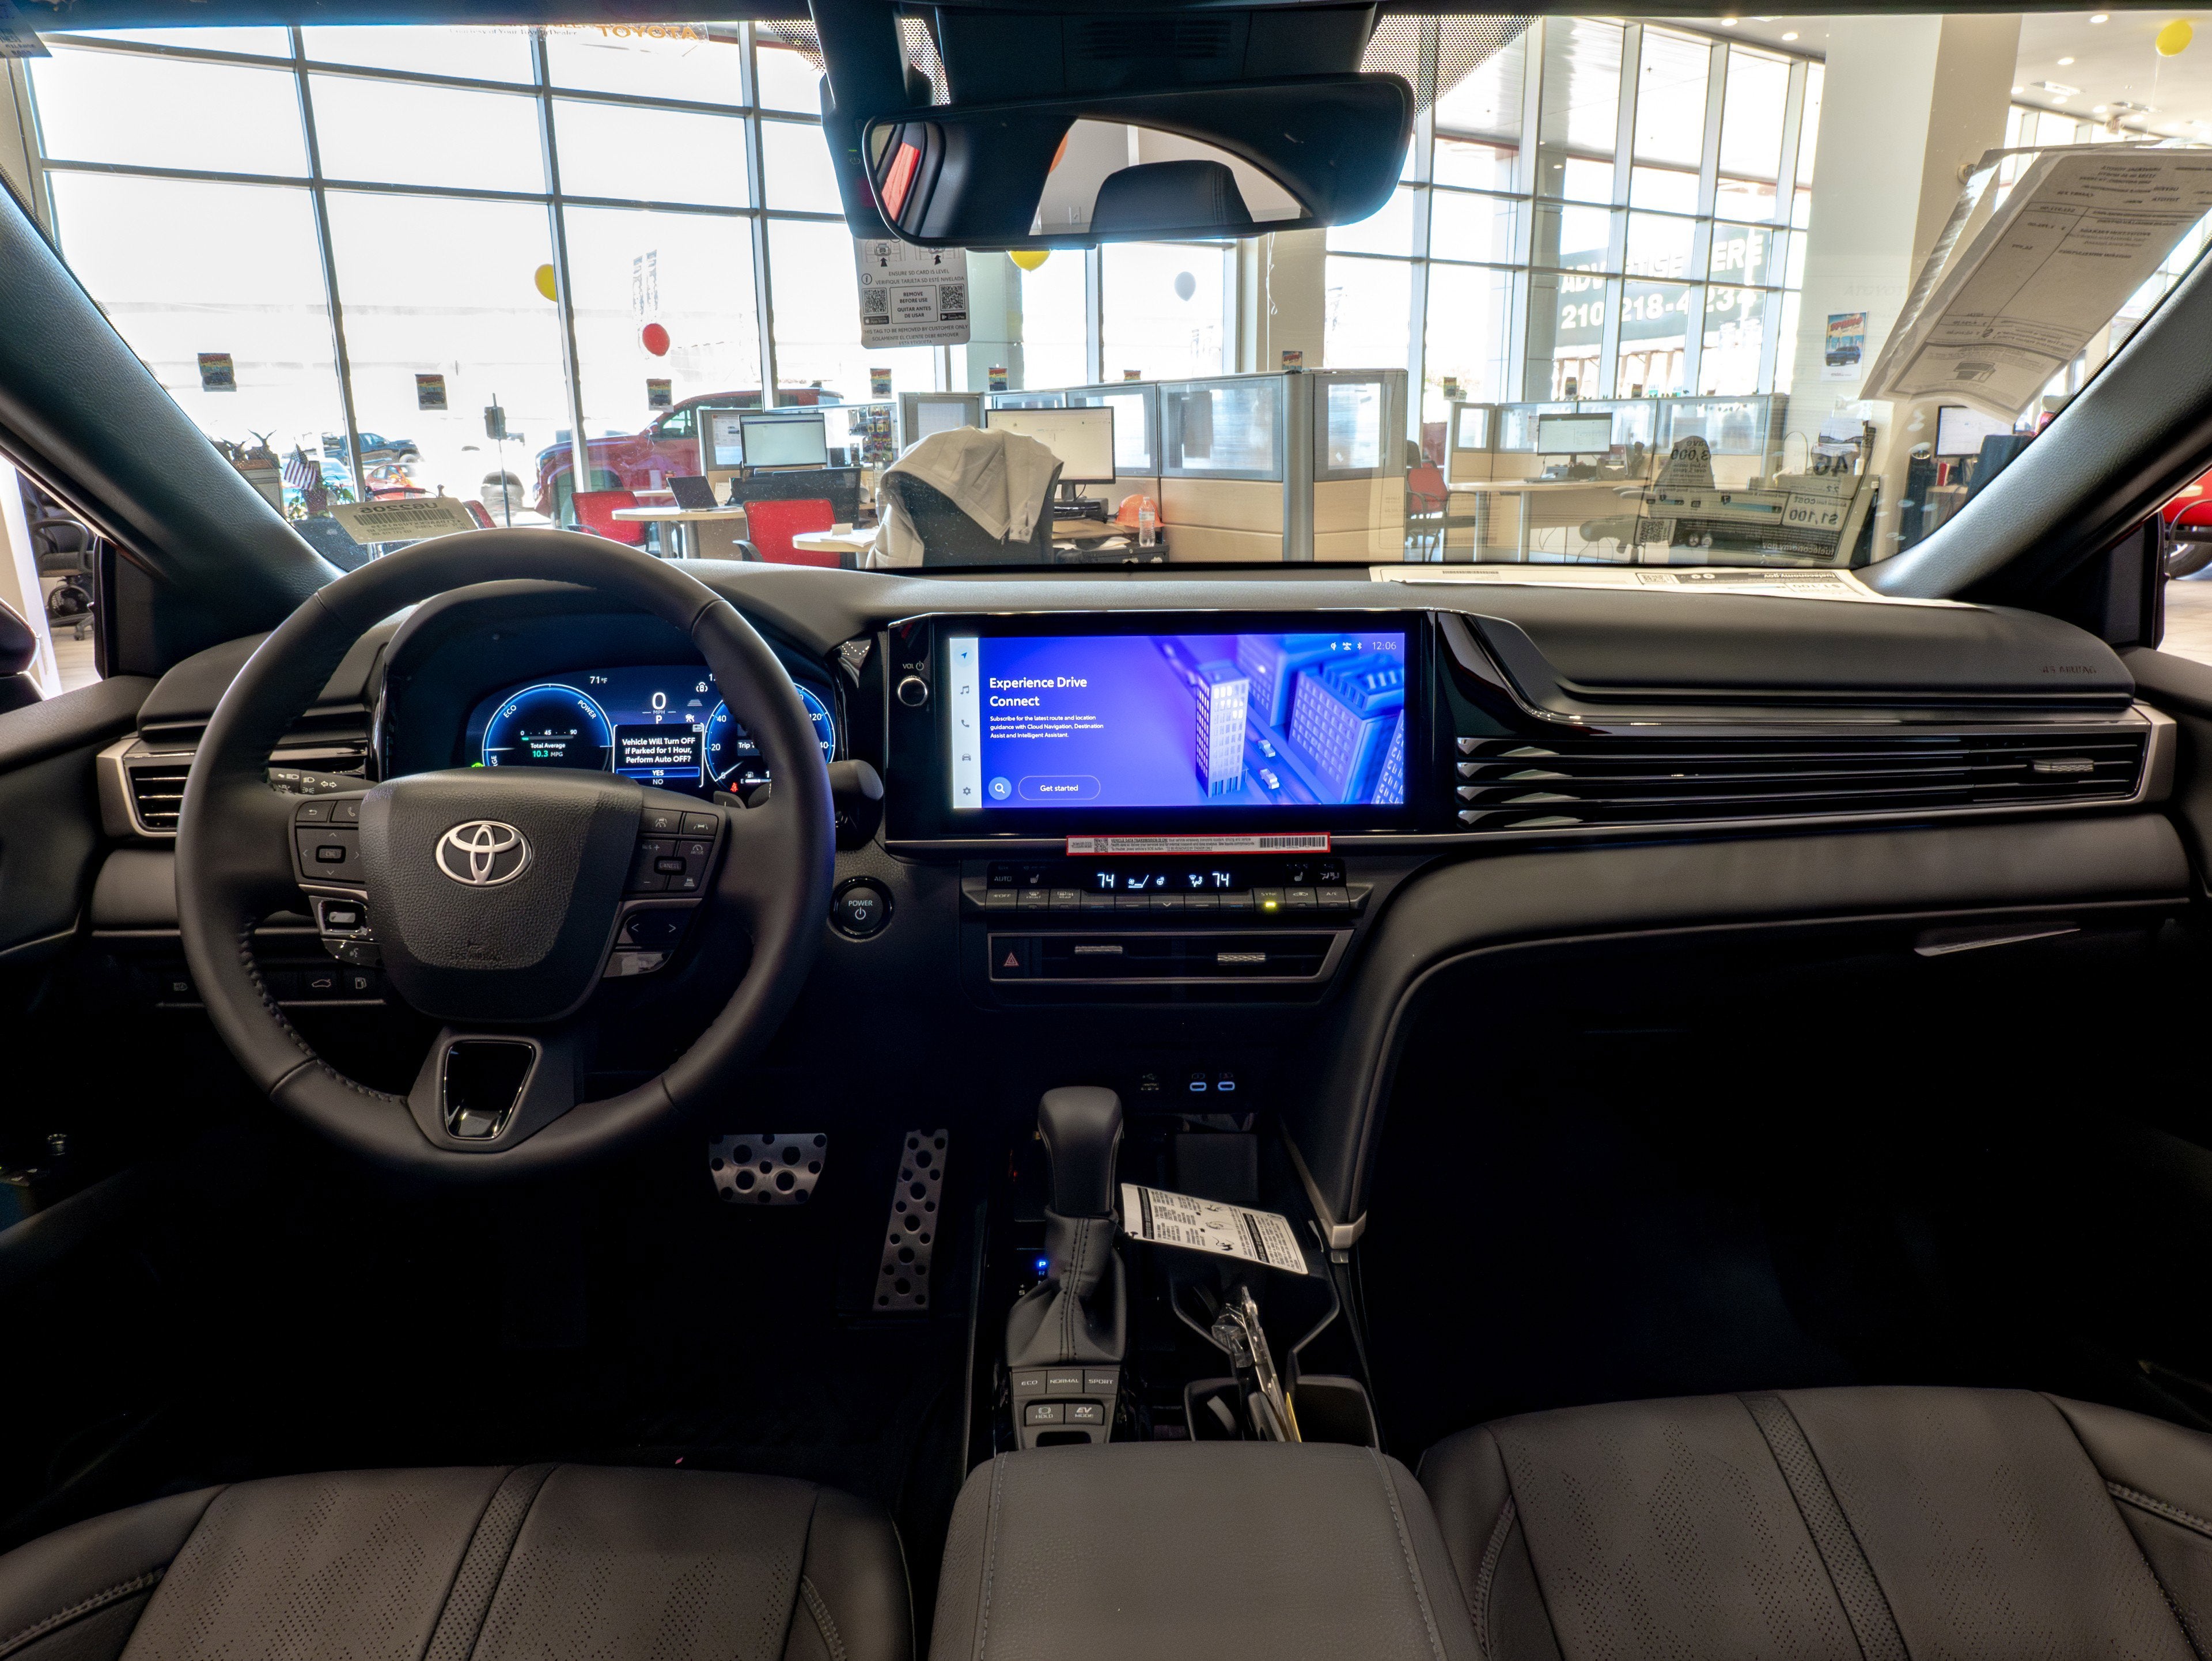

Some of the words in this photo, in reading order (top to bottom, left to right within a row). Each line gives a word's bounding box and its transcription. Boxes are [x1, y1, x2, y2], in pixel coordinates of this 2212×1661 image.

[596, 25, 699, 40] TOYOTA
[1372, 641, 1397, 650] 12:06
[990, 677, 1054, 691] Experience
[1056, 676, 1088, 688] Drive
[652, 692, 666, 710] 0
[990, 695, 1040, 707] Connect
[503, 705, 517, 718] ECO
[577, 699, 597, 720] POWER
[656, 715, 662, 724] P
[716, 714, 727, 722] 40
[673, 747, 693, 755] Hour,
[738, 741, 751, 750] Trip
[1040, 784, 1055, 793] Get
[1056, 784, 1078, 793] started
[1097, 873, 1115, 888] 74
[1212, 872, 1229, 888] 74
